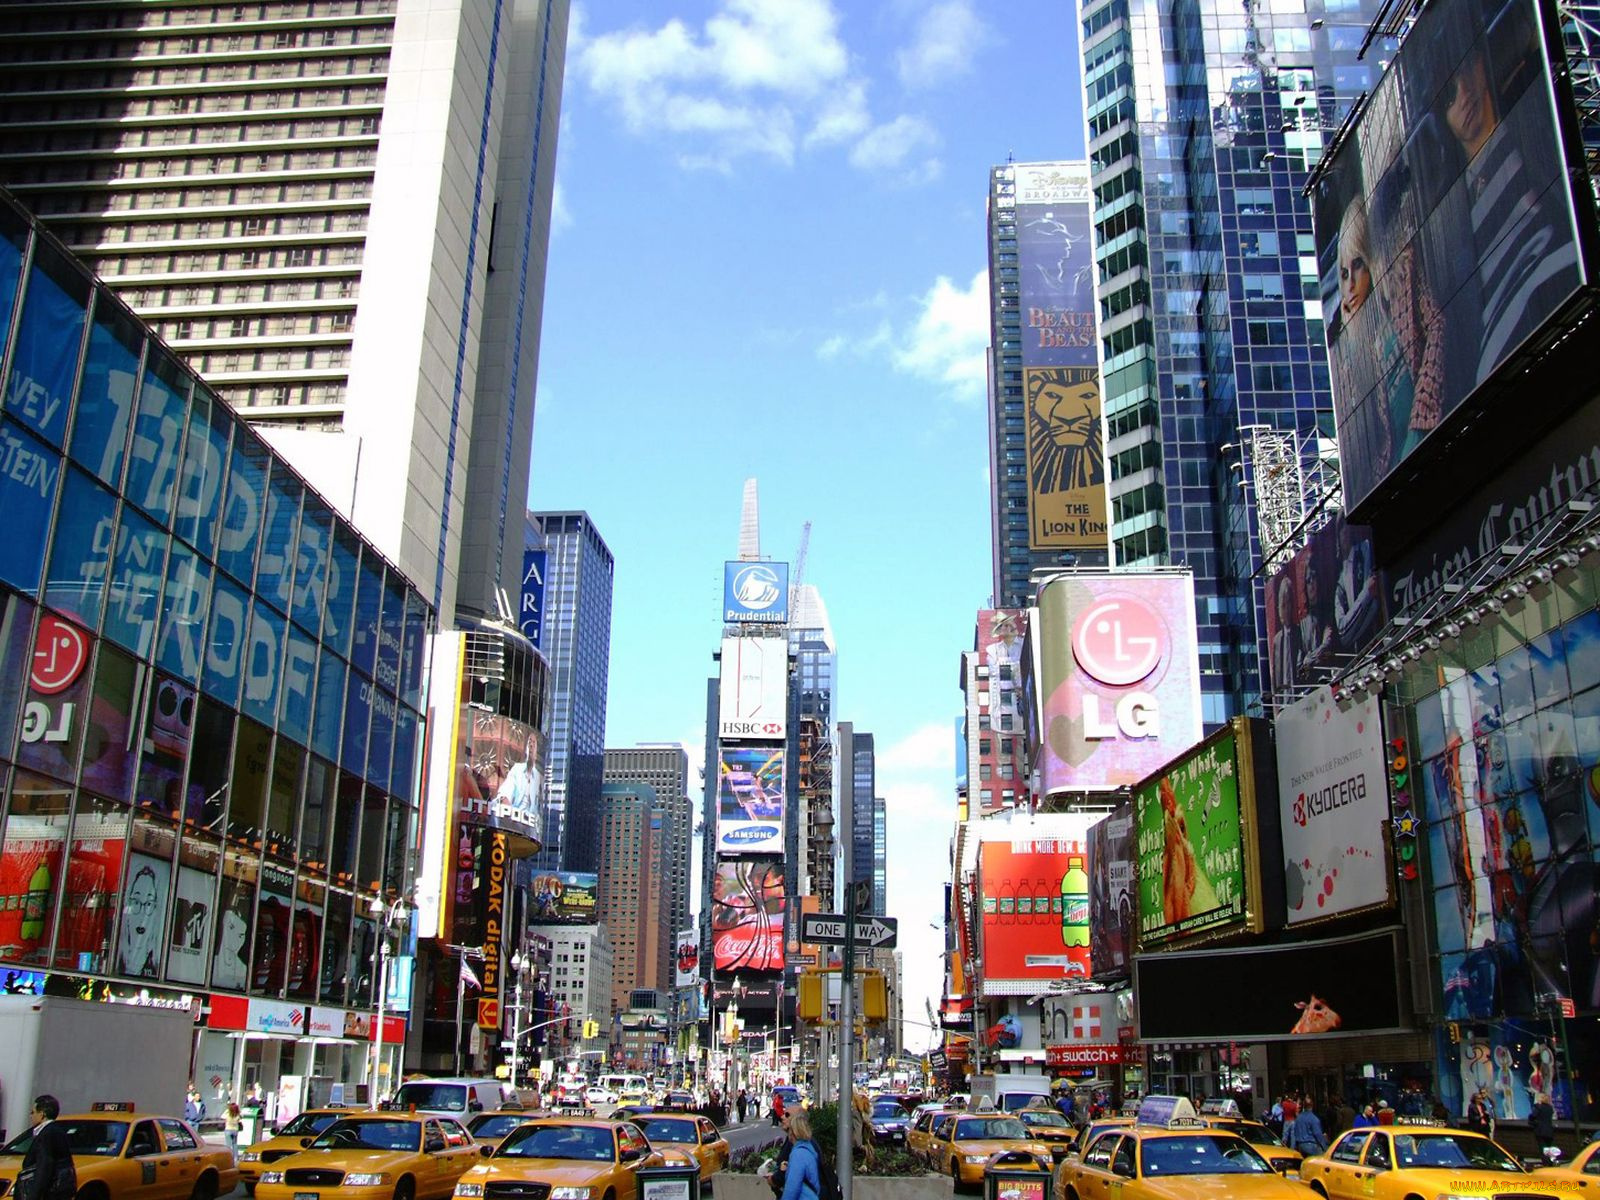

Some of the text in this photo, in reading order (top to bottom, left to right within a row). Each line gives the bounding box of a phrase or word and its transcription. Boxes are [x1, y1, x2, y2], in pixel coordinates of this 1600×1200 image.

[1065, 504, 1089, 514] THE
[1042, 519, 1075, 537] LION
[727, 610, 785, 622] Prudential
[1082, 692, 1159, 742] LG
[723, 722, 761, 734] HSBC
[1307, 773, 1366, 819] KYOCERA
[729, 830, 772, 840] SAMSUNG
[1036, 841, 1055, 854] MORE
[482, 832, 505, 993] KODAK digital
[815, 923, 840, 936] ONE
[859, 925, 885, 938] WAY
[1063, 1049, 1108, 1062] swatch
